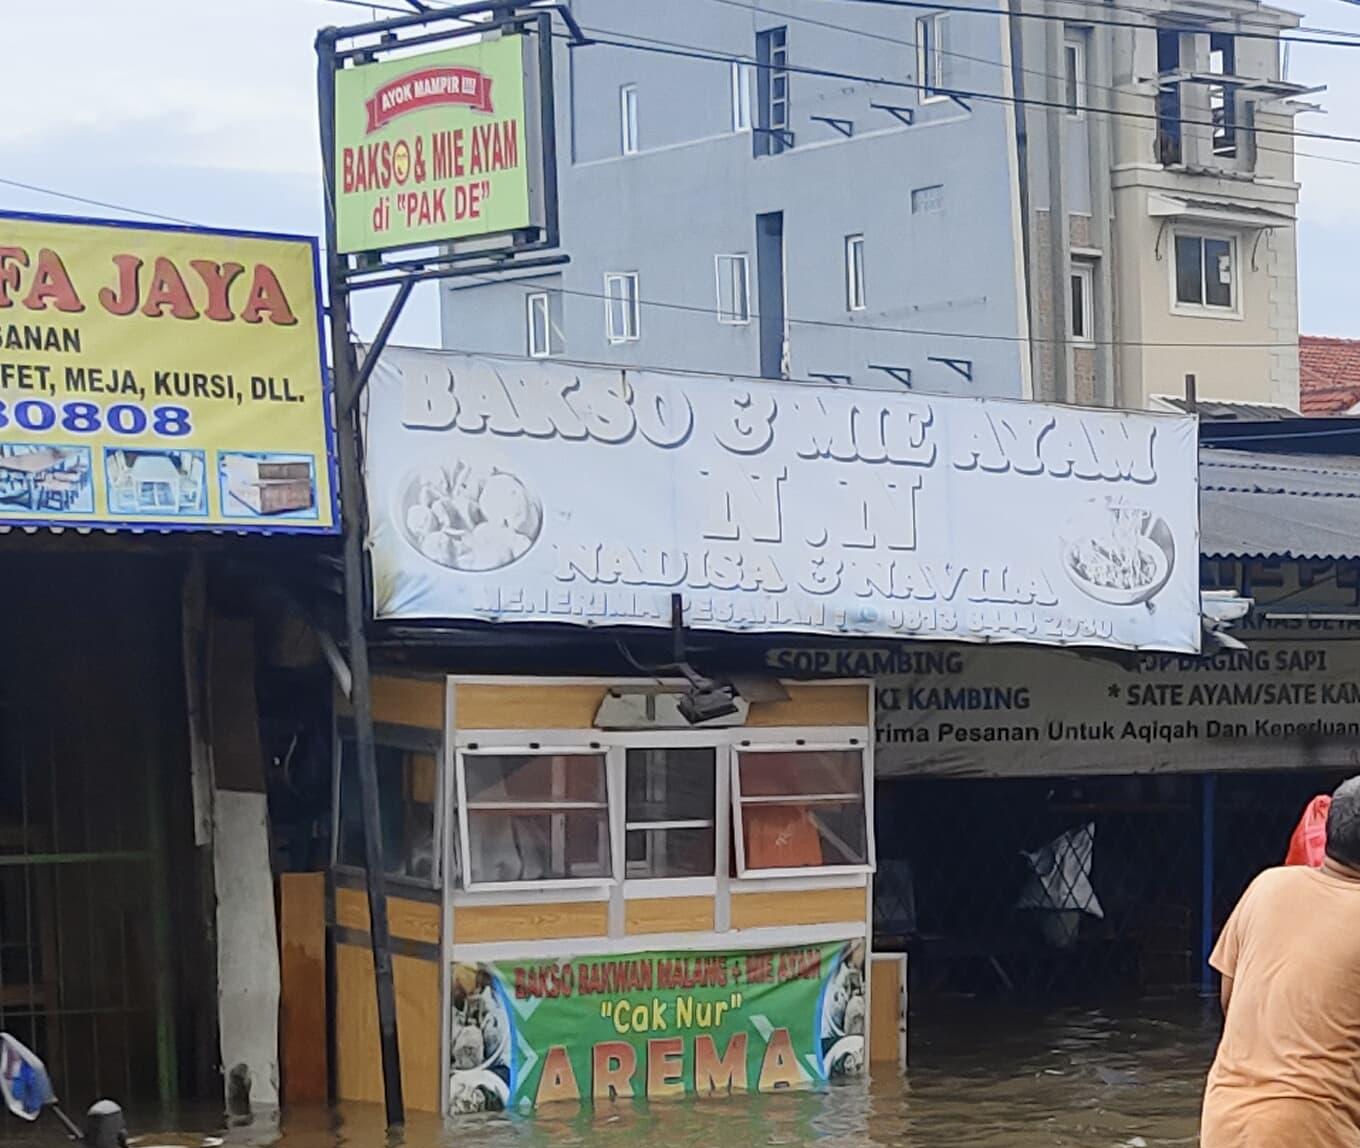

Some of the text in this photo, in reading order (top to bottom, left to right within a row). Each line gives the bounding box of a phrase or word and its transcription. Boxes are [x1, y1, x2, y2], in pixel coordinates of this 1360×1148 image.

[382, 84, 414, 111] AYOK
[414, 76, 460, 98] MAMPIR
[343, 120, 518, 194] BAKSO & MIE AYAM
[373, 196, 390, 232] di
[99, 254, 298, 326] JAYA
[0, 363, 305, 406] FET, MEJA, KURSI, DLL.
[0, 400, 193, 437] 0808
[401, 364, 695, 450] BAKSO
[796, 398, 938, 468] MIE
[954, 410, 1158, 485] AYAM
[777, 651, 964, 676] SOP KAMBING
[1275, 650, 1327, 671] SAPI
[908, 687, 1030, 711] KAMBING
[1127, 684, 1184, 706] SATE
[1189, 683, 1318, 706] AYAM/SATE
[937, 722, 1040, 744] Pesanan
[1046, 720, 1114, 743] Untuk
[1120, 721, 1199, 745] Aqiqah
[1206, 720, 1248, 738] Dan
[514, 963, 575, 999] BAKSO
[578, 957, 653, 996] BAKWAN
[535, 1028, 805, 1105] AREMA
